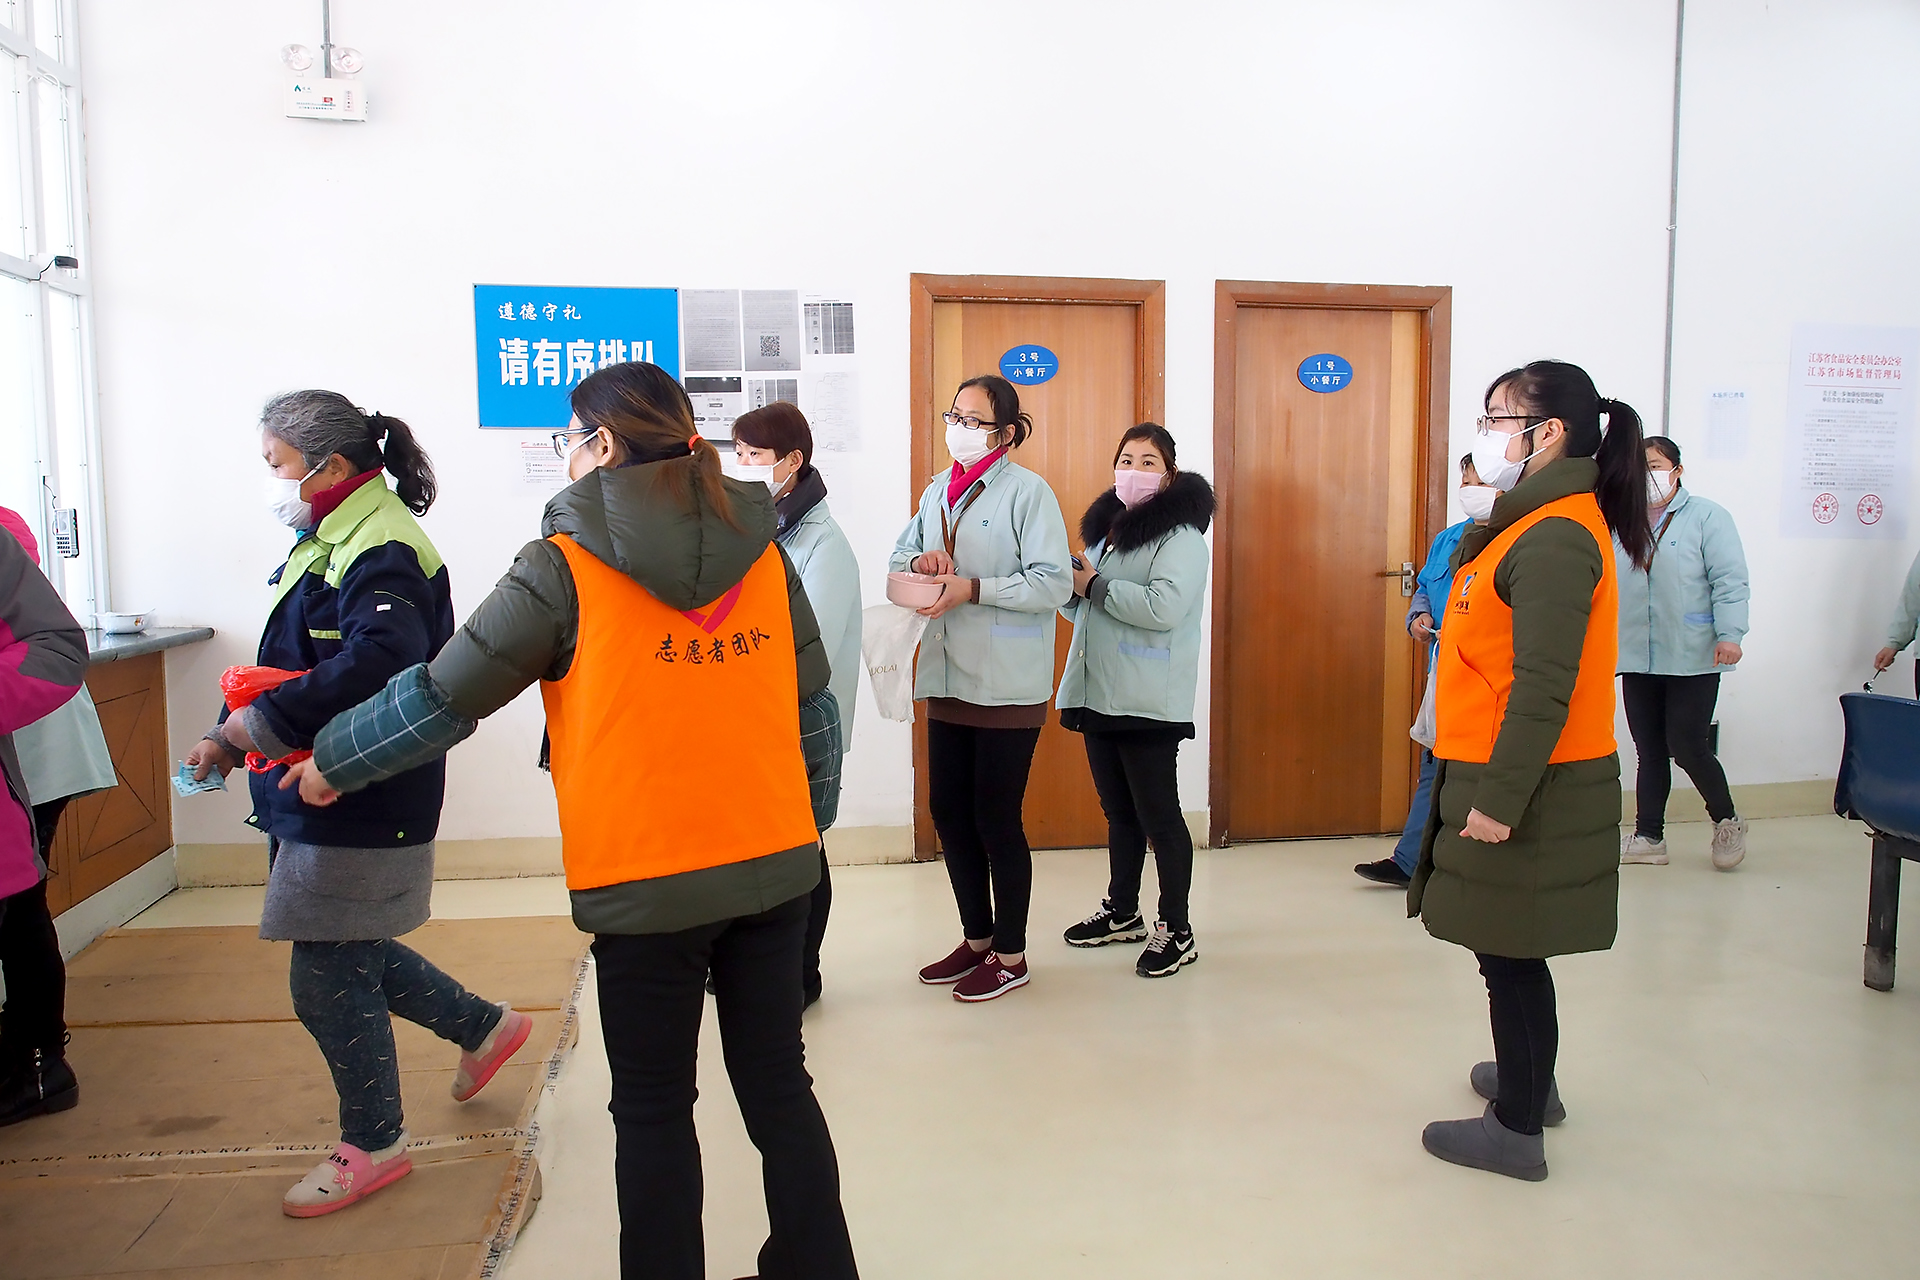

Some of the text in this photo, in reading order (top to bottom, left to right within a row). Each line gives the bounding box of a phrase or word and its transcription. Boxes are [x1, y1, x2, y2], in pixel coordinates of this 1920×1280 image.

[498, 301, 582, 321] 遵德守礼
[1019, 352, 1039, 362] 3号
[1808, 352, 1902, 367] 江苏省食品安全委员会办公室
[1316, 360, 1335, 371] 1号
[1013, 367, 1046, 378] 小餐厅
[1807, 366, 1901, 380] 江苏省市场监督管理局
[1310, 375, 1341, 385] 小餐厅
[655, 627, 770, 664] 志愿者团队
